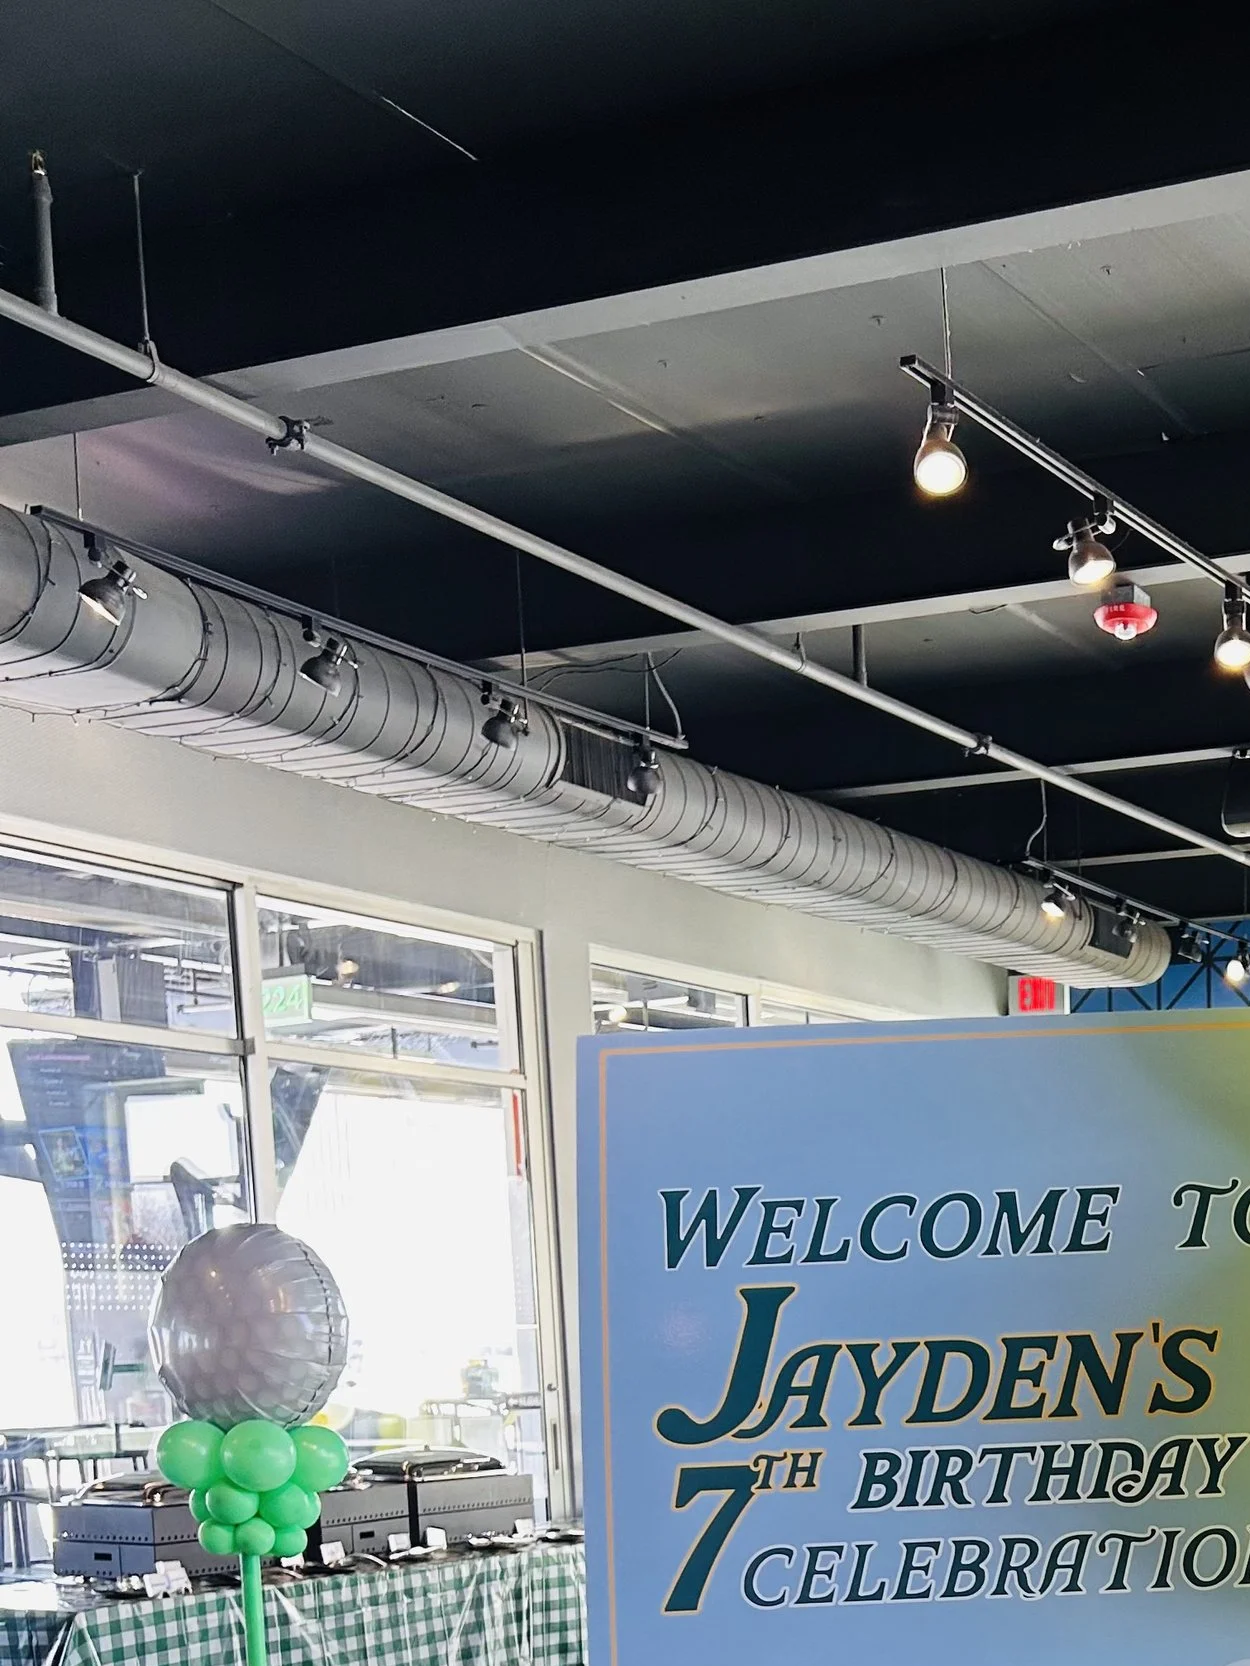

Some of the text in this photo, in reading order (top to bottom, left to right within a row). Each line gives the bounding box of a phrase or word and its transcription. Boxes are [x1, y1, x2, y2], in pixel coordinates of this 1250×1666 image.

[658, 1186, 1121, 1271] WELCOME
[655, 1285, 1219, 1444] JAYDEN'S
[848, 1433, 1249, 1512] BIRTHDAY
